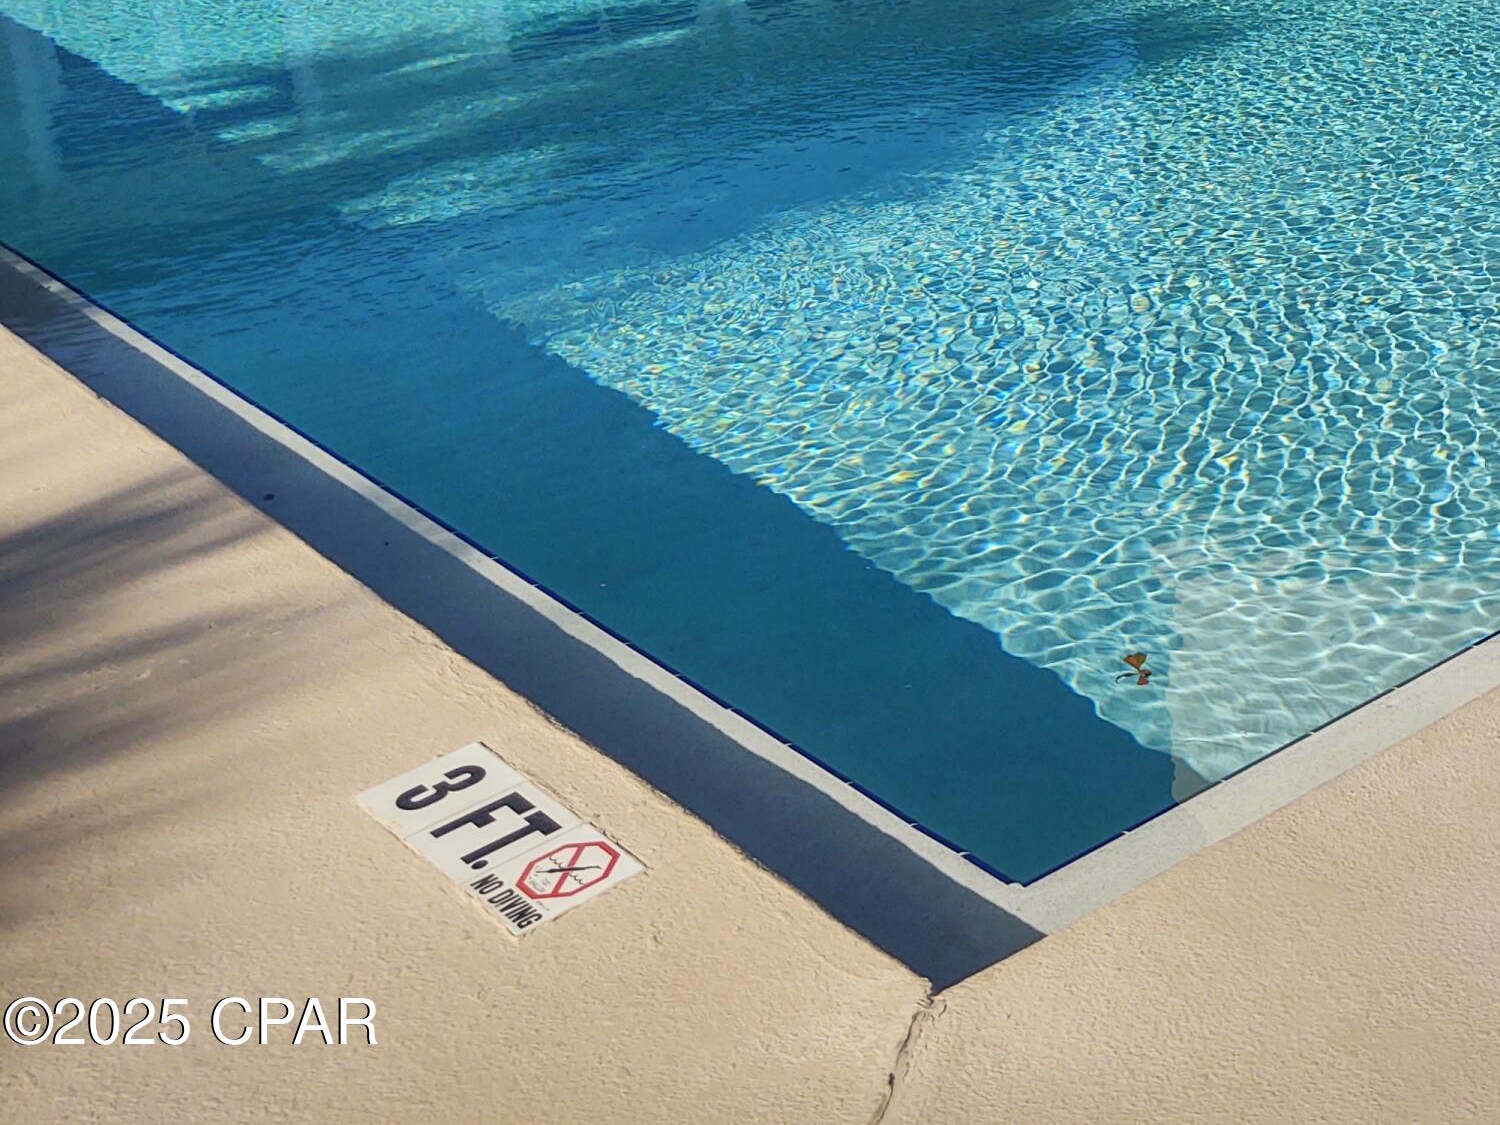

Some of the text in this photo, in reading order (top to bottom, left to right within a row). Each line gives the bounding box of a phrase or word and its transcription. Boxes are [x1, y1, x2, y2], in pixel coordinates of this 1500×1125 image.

[396, 764, 562, 870] 3 FT.
[470, 873, 496, 895] NO
[489, 889, 544, 930] DIVING
